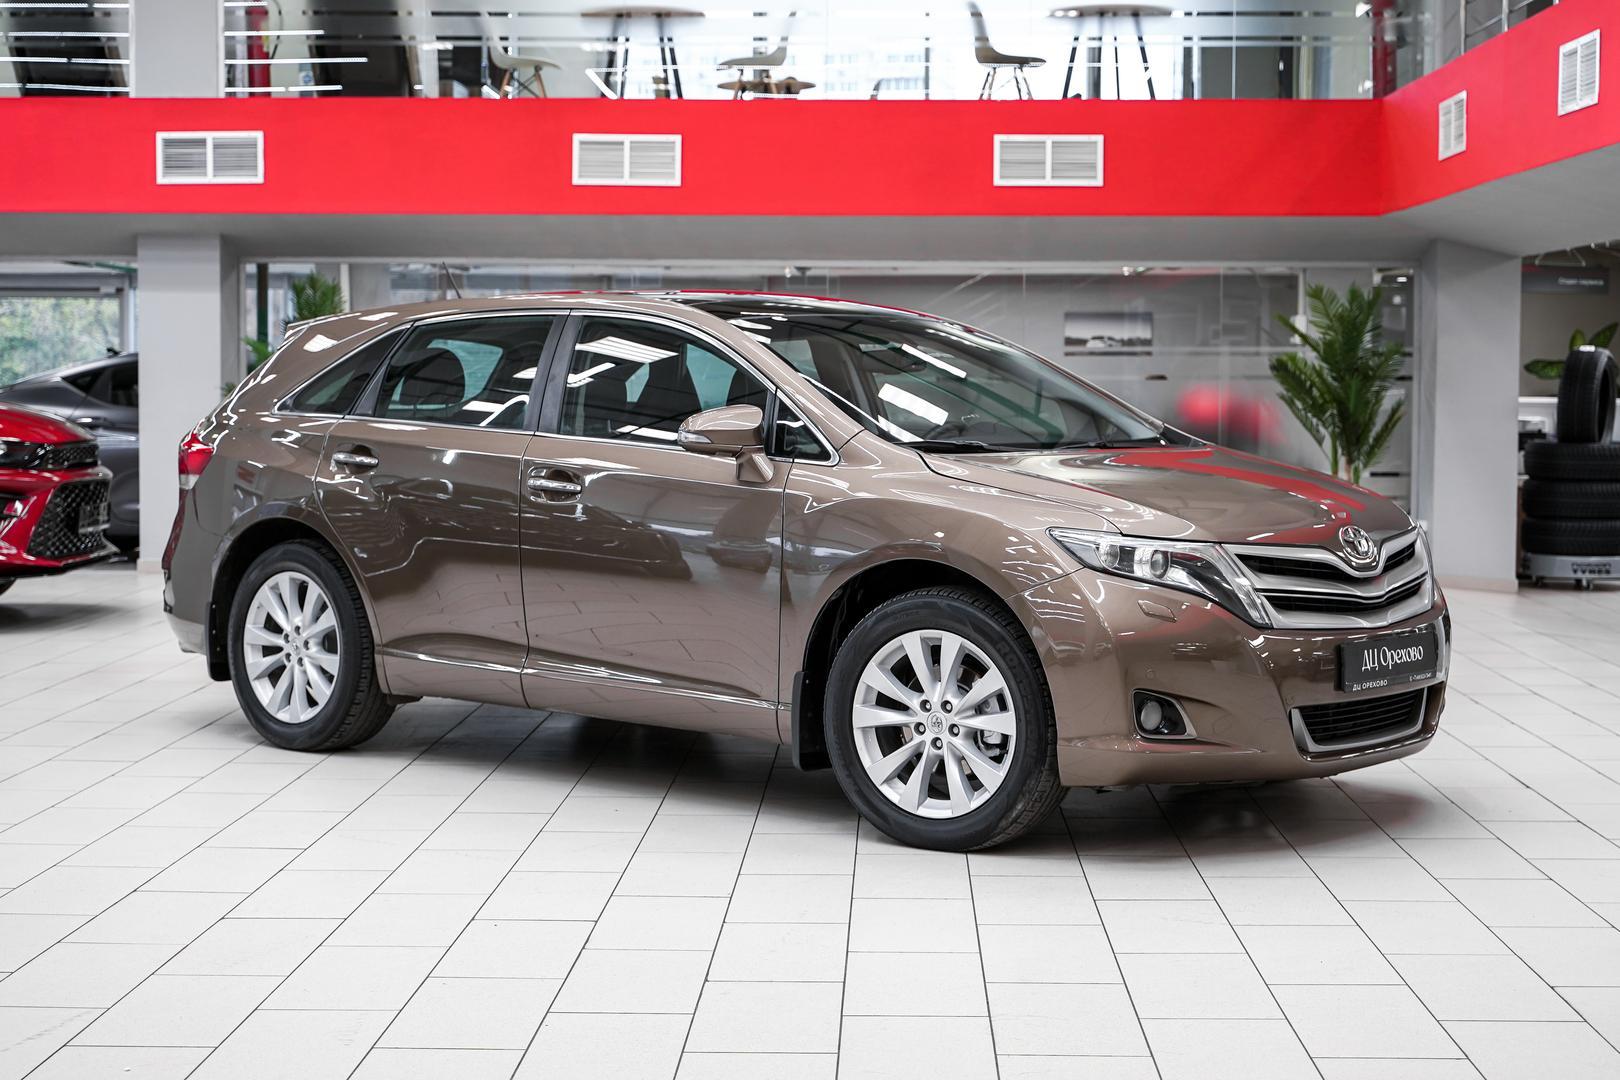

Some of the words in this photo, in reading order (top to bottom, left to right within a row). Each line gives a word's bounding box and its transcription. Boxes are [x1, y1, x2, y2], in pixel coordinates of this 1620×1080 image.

[1362, 648, 1379, 672] ДЦ
[1380, 645, 1424, 669] Орехово
[1352, 683, 1361, 692] ДЦ
[1362, 679, 1388, 690] ОРЕХОВО
